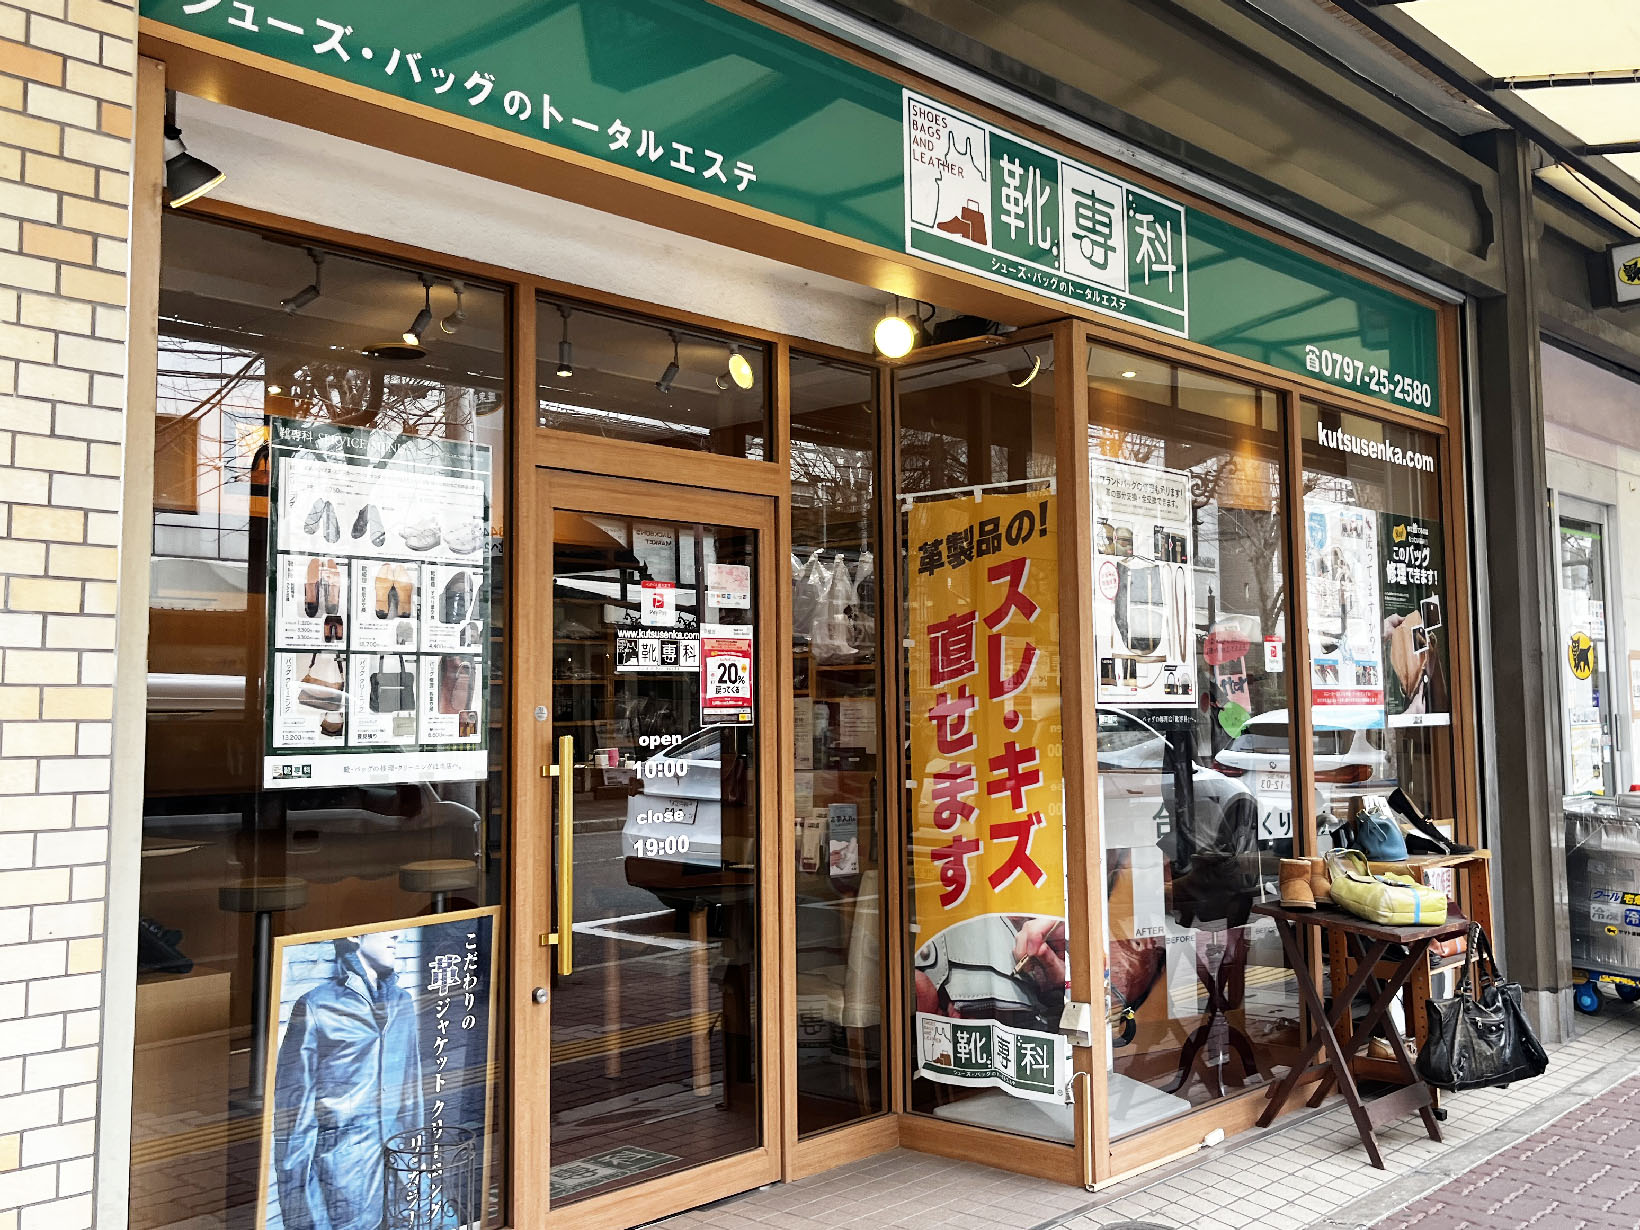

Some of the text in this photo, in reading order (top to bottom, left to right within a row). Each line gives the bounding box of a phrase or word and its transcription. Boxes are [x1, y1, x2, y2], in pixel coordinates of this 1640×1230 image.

[911, 104, 949, 129] SHOES
[911, 120, 942, 140] BAGS
[911, 134, 935, 152] AND
[911, 149, 965, 179] LEATHER
[1000, 153, 1177, 293] 靴専科
[990, 257, 1127, 311] シューズ・バッグのトータルエステ
[1321, 349, 1432, 408] 0797-25-2580
[1317, 421, 1434, 472] kutsusenka.com
[1392, 545, 1431, 567] このバッグ
[616, 628, 700, 640] www.kutsusenka.com
[640, 642, 698, 664] 靴専科
[982, 556, 1049, 894] スレ・キズ
[638, 734, 683, 750] open
[632, 759, 689, 780] 10:00
[926, 610, 984, 910] 直せます
[635, 809, 685, 826] close
[633, 834, 690, 859] 19:00
[1135, 926, 1165, 937] AFTER
[1165, 934, 1195, 945] BEFORE
[461, 932, 478, 1030] こだわりの
[956, 1029, 1050, 1079] 靴専科
